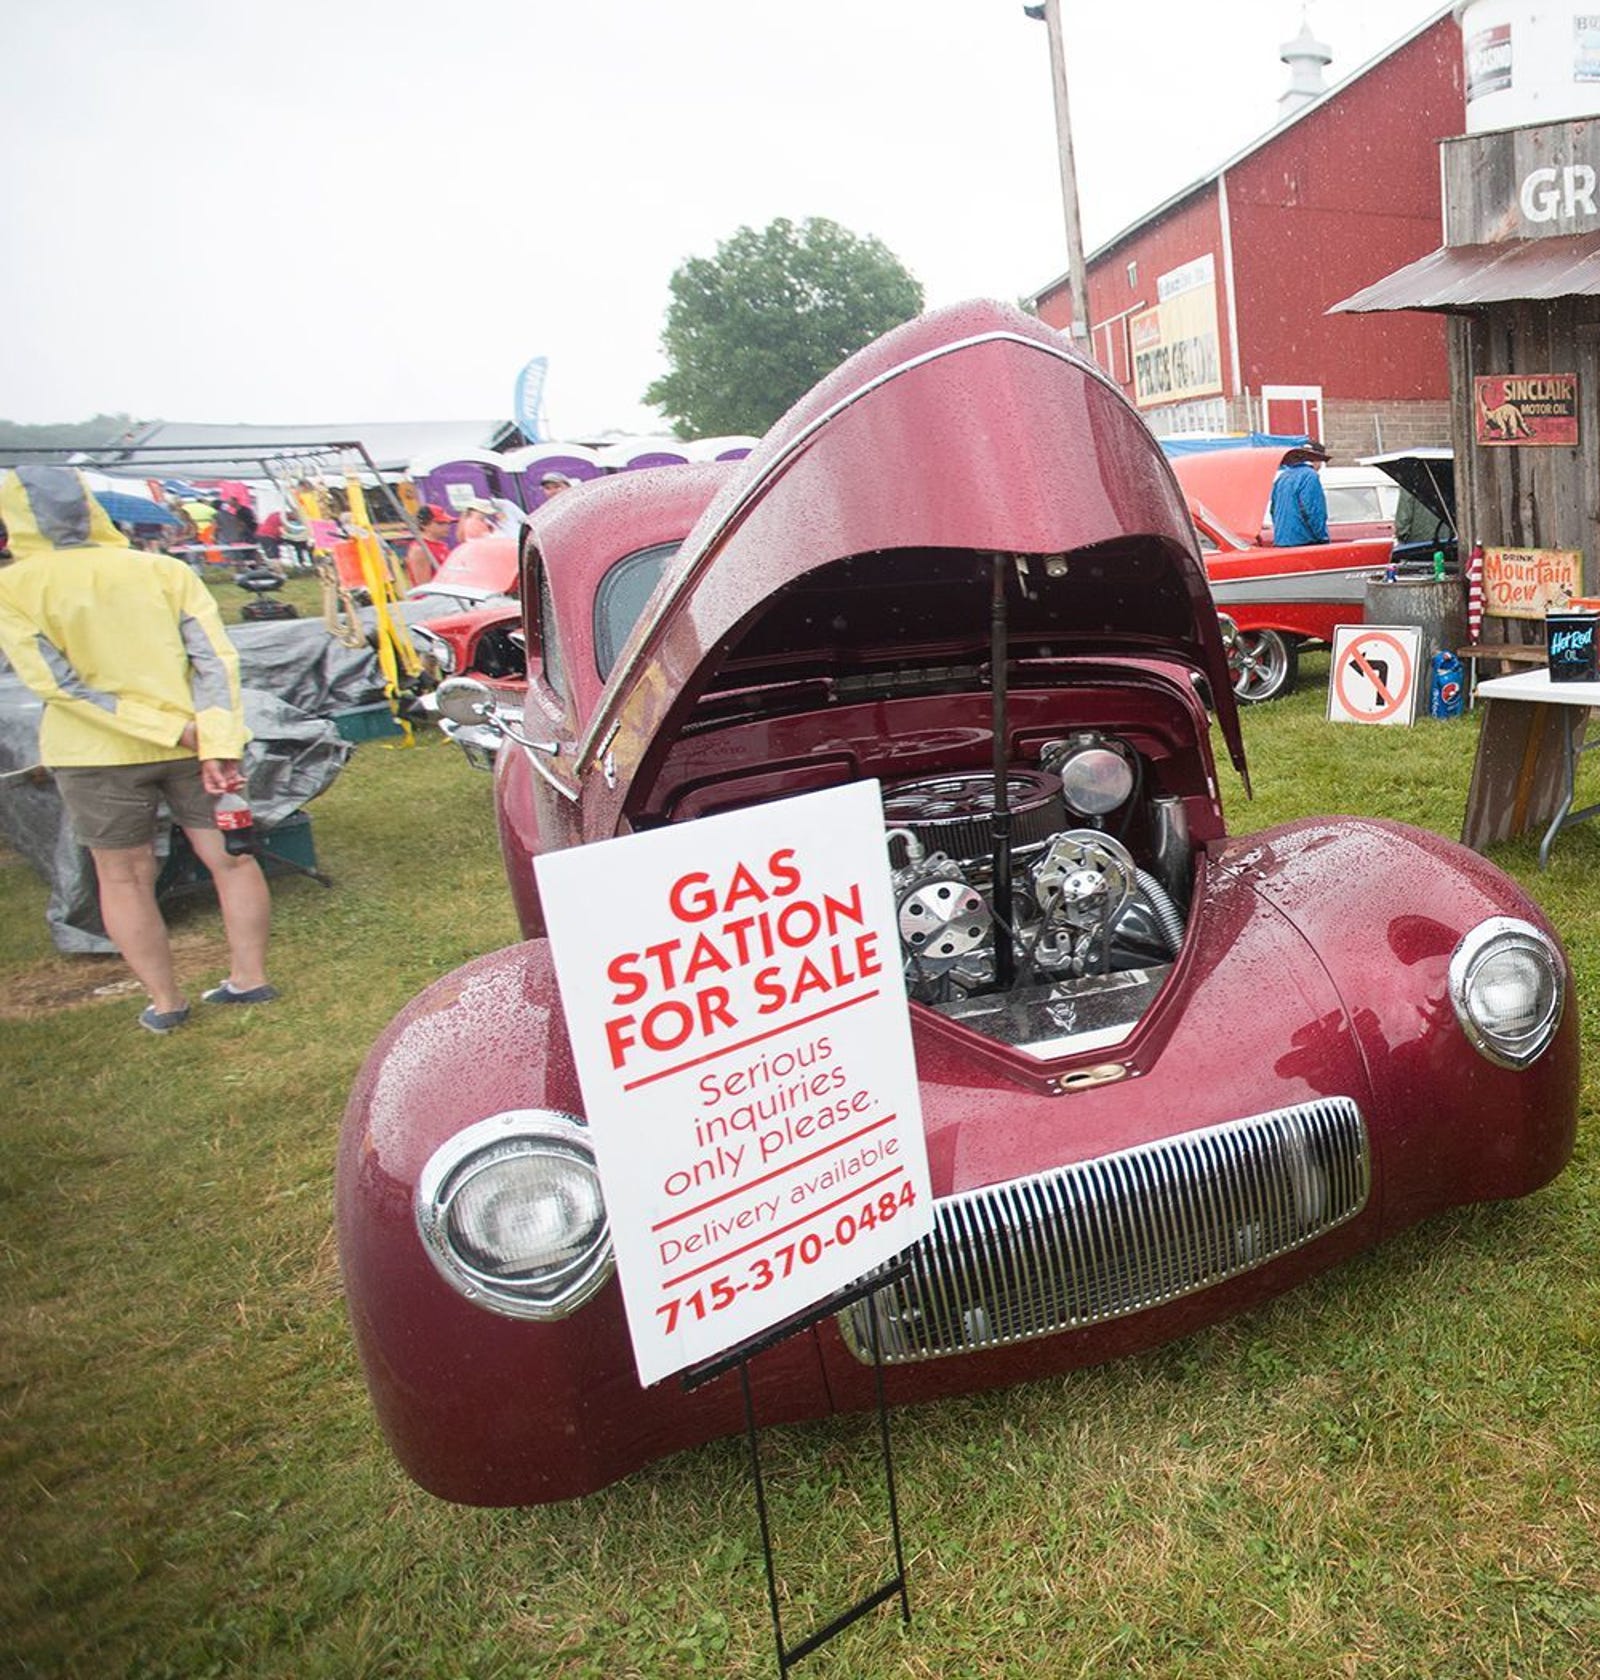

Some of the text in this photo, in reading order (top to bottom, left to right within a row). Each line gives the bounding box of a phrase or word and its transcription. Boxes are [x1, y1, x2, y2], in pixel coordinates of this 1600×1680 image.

[1503, 379, 1572, 400] SINCLAIR
[1521, 404, 1568, 415] MOTOR OIL
[1486, 555, 1571, 586] Mountain
[1491, 581, 1537, 604] Dew
[668, 849, 802, 924] GAS
[606, 884, 864, 1006] STATION
[604, 931, 883, 1070] FOR SALE
[694, 1066, 847, 1148] inquiries
[698, 1032, 833, 1106] Serious
[664, 1085, 880, 1197] only please.
[659, 1135, 900, 1266] Delivery available
[655, 1180, 917, 1335] 715-370-0484
